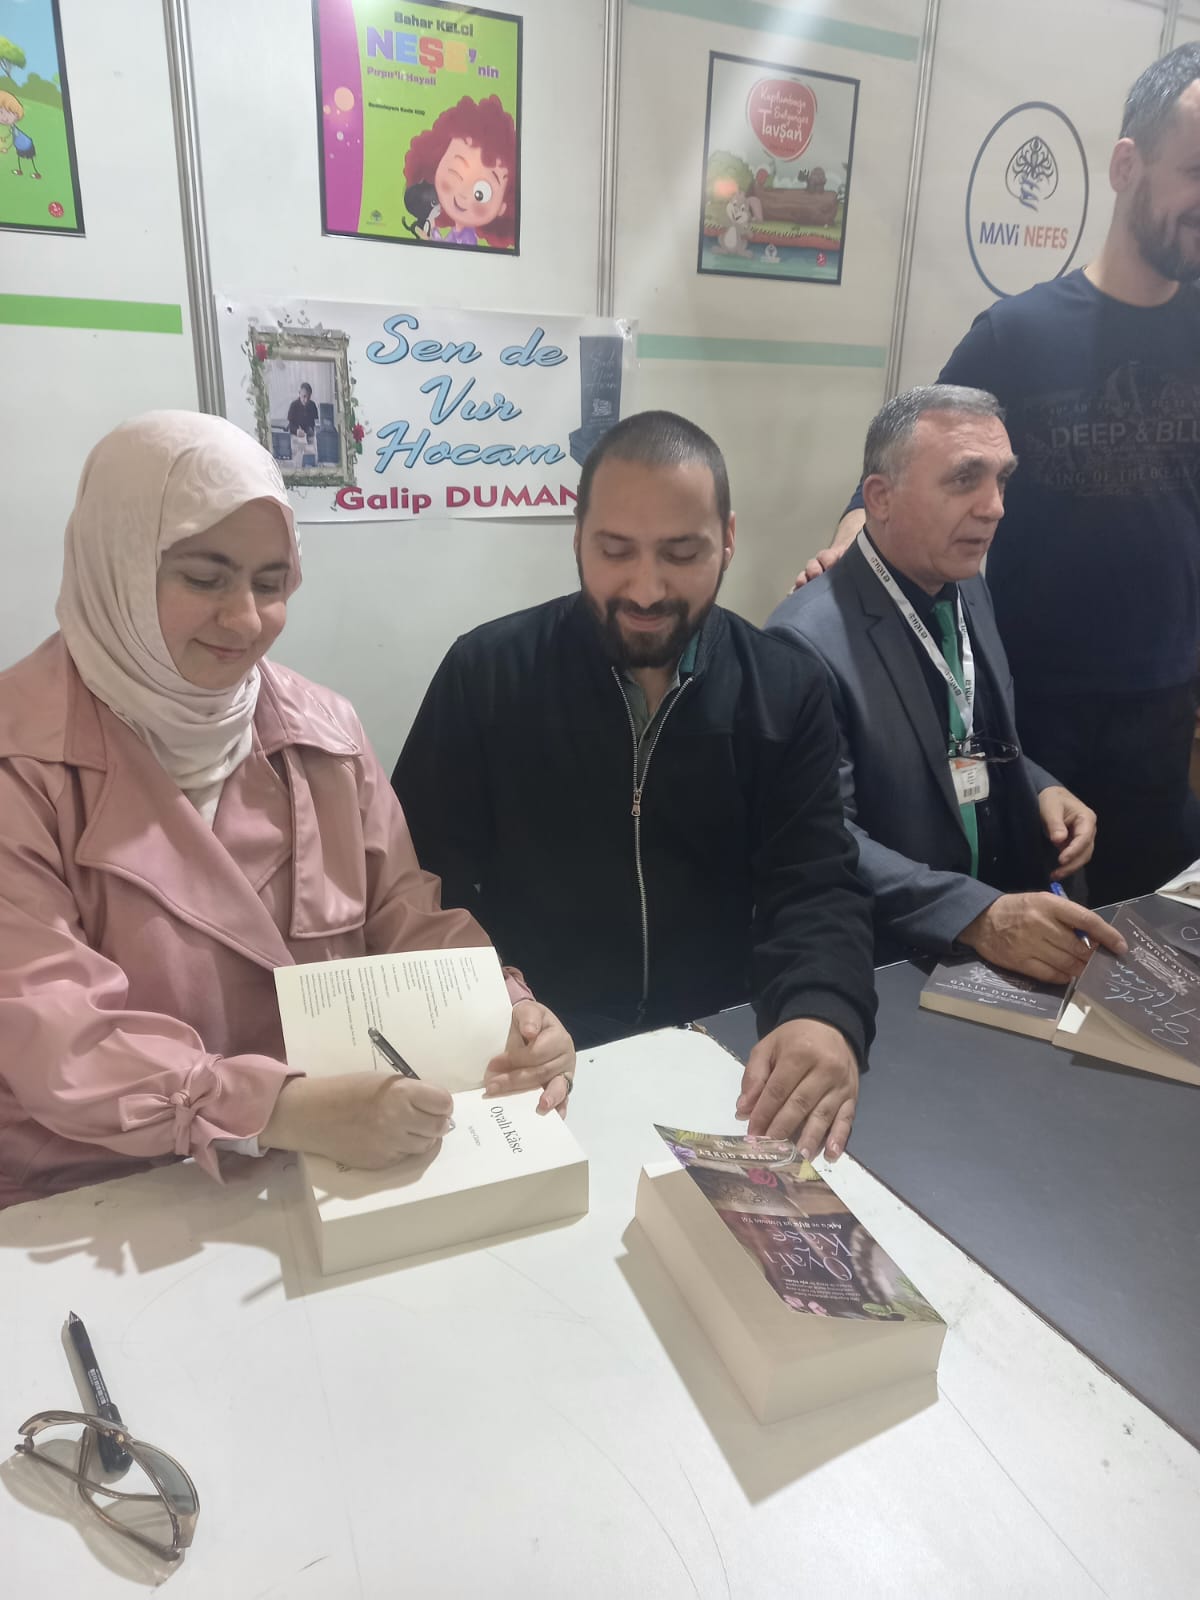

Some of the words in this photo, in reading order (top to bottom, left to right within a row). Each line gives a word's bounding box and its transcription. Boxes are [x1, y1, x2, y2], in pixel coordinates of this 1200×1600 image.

[394, 11, 433, 30] Bahar
[758, 107, 803, 142] Tavşan
[1023, 225, 1069, 250] NEFES
[366, 313, 482, 365] Sen
[499, 326, 568, 368] de
[420, 374, 522, 426] Vur
[374, 419, 567, 474] Hocam
[1051, 421, 1126, 449] DEEP
[1135, 423, 1149, 443] &
[335, 485, 432, 514] Galip
[445, 484, 579, 508] DUMAN
[991, 989, 1037, 1004] DUMAN
